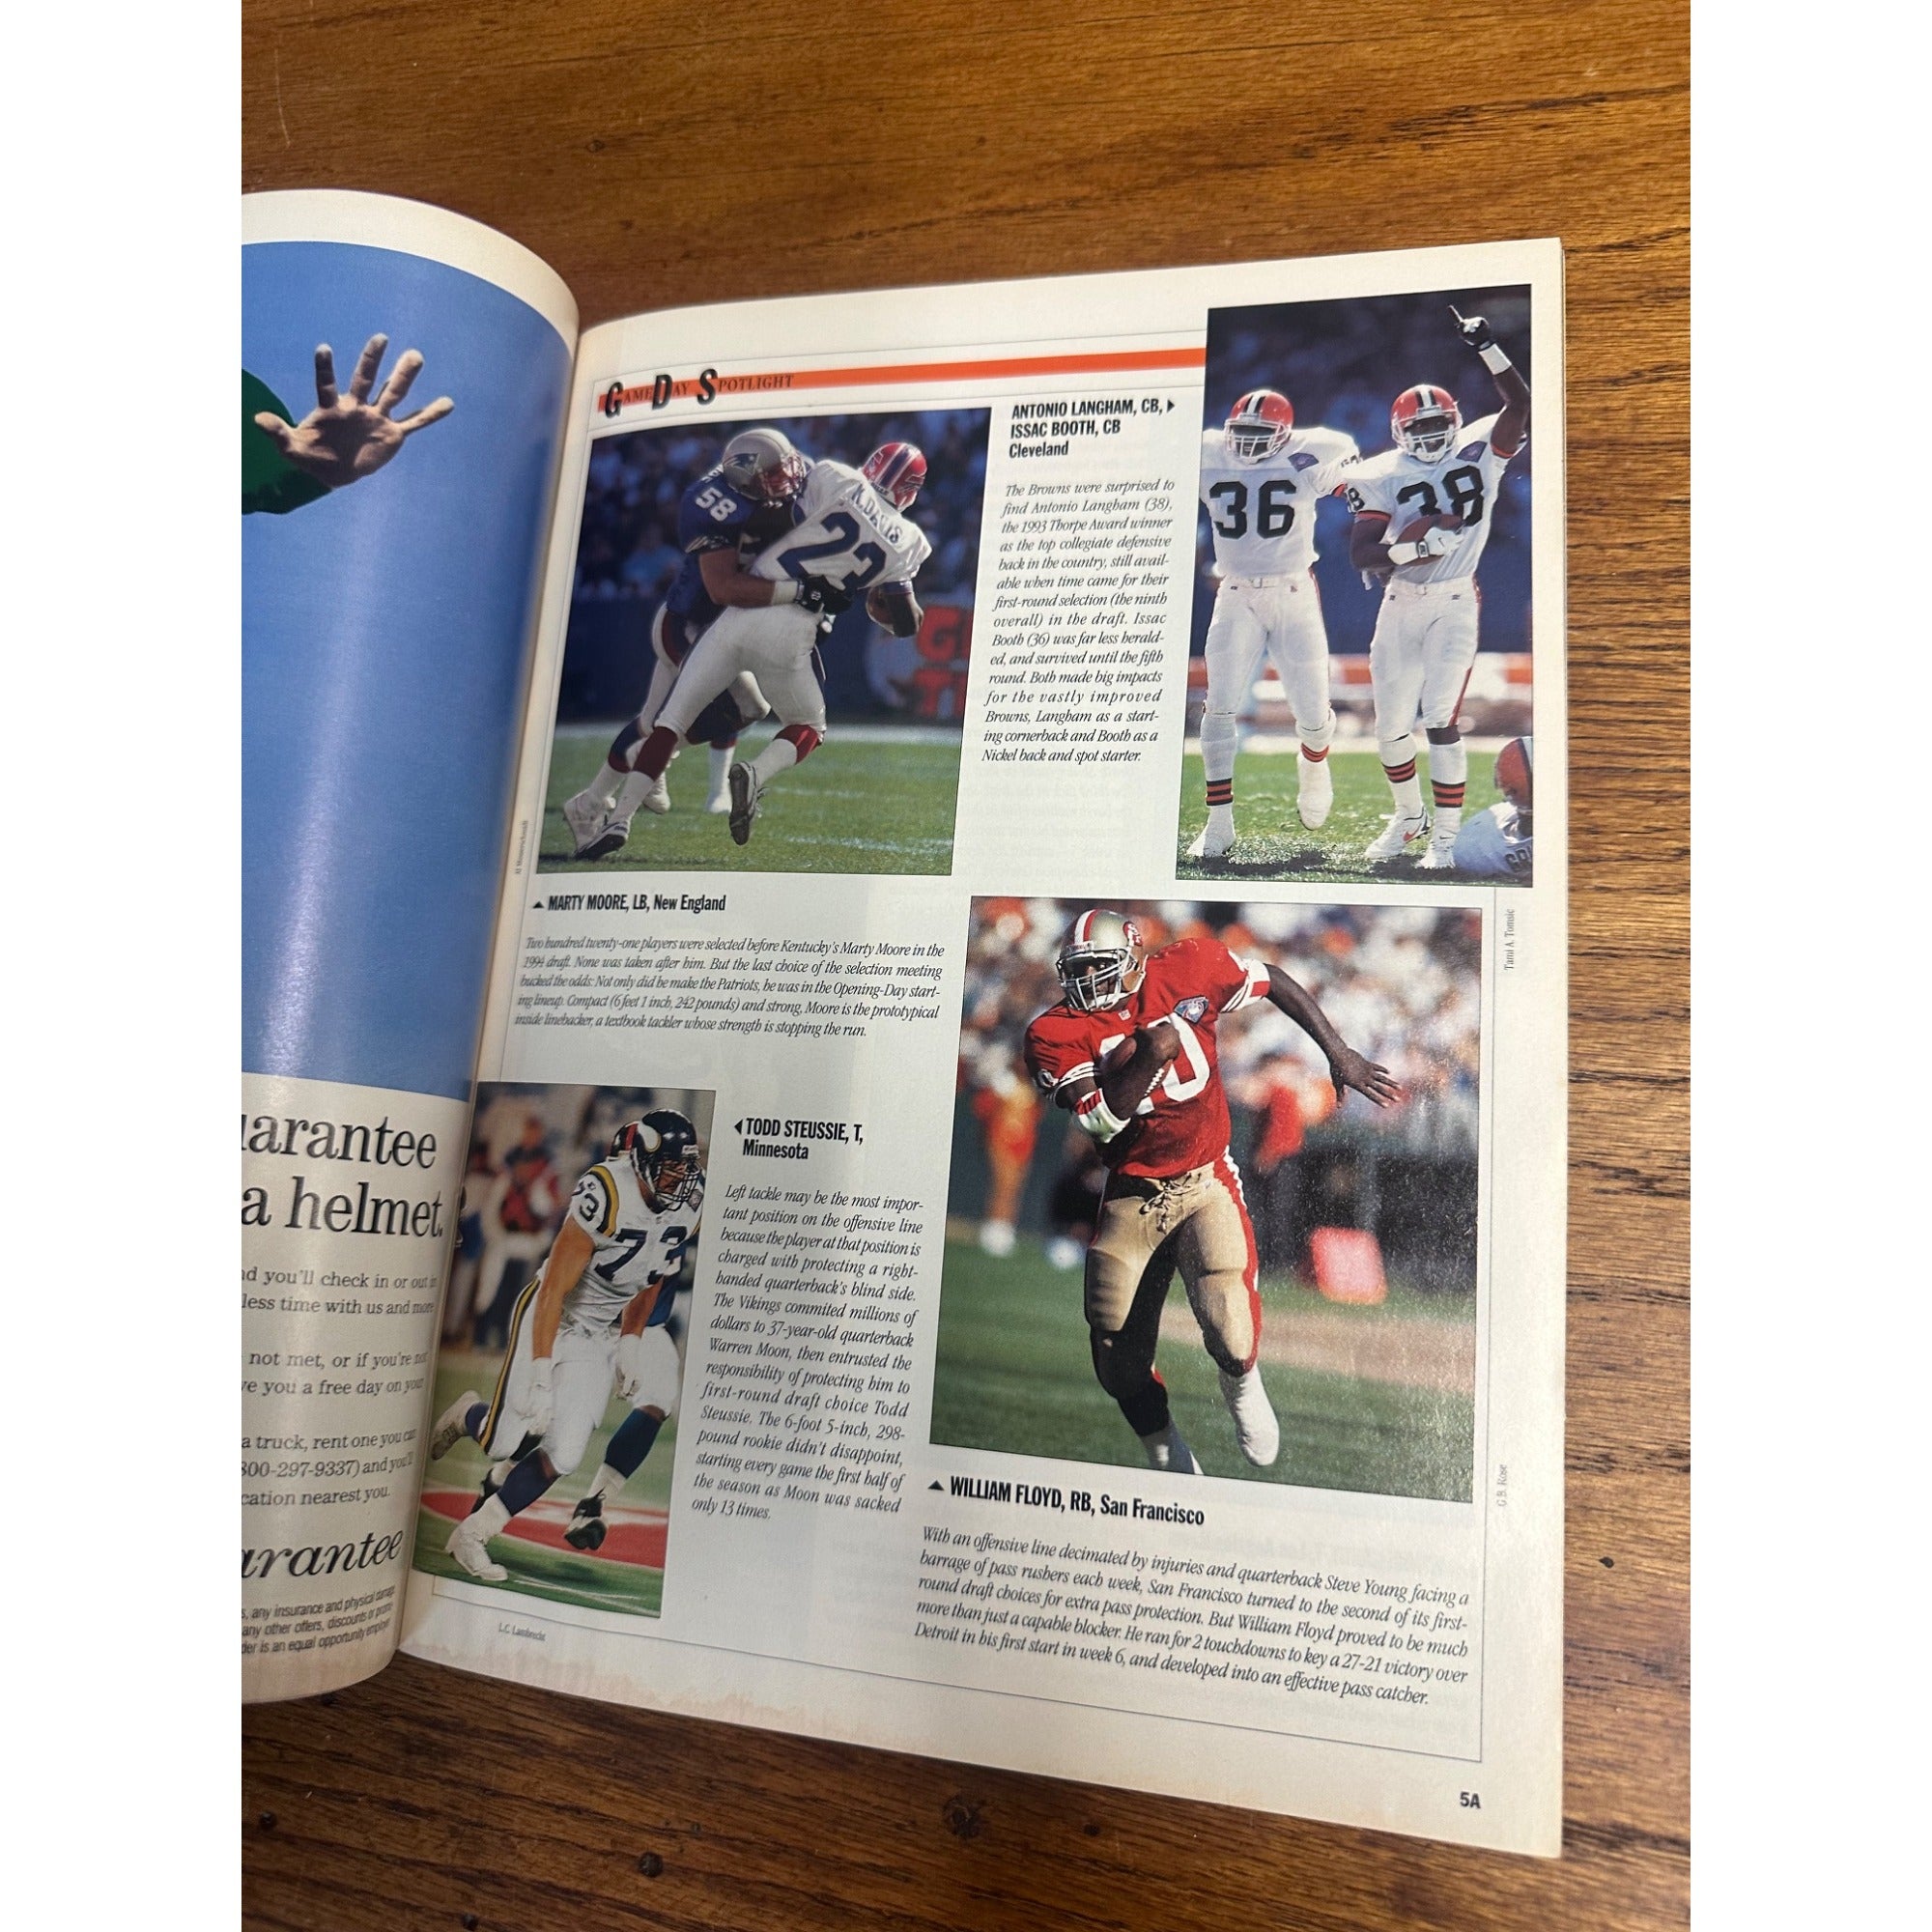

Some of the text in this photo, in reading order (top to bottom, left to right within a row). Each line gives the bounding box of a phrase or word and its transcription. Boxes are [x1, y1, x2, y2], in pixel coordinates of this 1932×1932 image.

[696, 368, 794, 405] SPOTLIGHT
[1011, 398, 1163, 419] ANTONIO LANGHAM, CB,
[1010, 419, 1121, 439] ISSAC BOOTH, CB
[1009, 440, 1069, 459] Cleveland
[696, 487, 737, 522] 58
[1000, 497, 1172, 519] find Antonio Langham (38),
[1209, 479, 1296, 539] 36
[1002, 516, 1173, 534] the 1993 Thorpe Award winner
[983, 689, 1163, 707] for the vastly improved
[984, 709, 1159, 725] Browns, Langham as a start-
[548, 895, 726, 914] MARTY MOORE, LB, New England
[544, 936, 586, 949] hundred
[583, 936, 640, 952] twenty-one
[639, 936, 678, 952] players
[679, 940, 704, 950] were
[704, 937, 747, 951] selected
[747, 938, 780, 954] before
[781, 940, 839, 956] Kentucky's
[839, 942, 874, 958] Marty
[874, 943, 911, 955] Moore
[912, 944, 925, 956] in
[926, 943, 945, 956] the
[595, 1017, 604, 1026] a
[605, 1014, 646, 1028] textbook
[647, 1015, 683, 1029] tackler
[684, 1016, 717, 1030] whose
[717, 1018, 762, 1035] strength
[764, 1020, 775, 1033] is
[775, 1021, 822, 1038] stopping
[823, 1021, 841, 1036] the
[843, 1026, 867, 1037] run.
[242, 1114, 437, 1169] arantee
[746, 1118, 863, 1146] TODD STEUSSIE, T,
[743, 1138, 809, 1159] Minnesota
[242, 1176, 442, 1237] a helmet.
[594, 1226, 688, 1285] 73
[262, 1270, 314, 1286] you'll
[320, 1271, 370, 1288] check
[374, 1274, 388, 1288] in
[393, 1278, 409, 1289] or
[280, 1296, 321, 1313] time
[325, 1299, 362, 1314] with
[366, 1303, 384, 1315] us
[385, 1300, 411, 1315] and
[710, 1315, 914, 1348] dollars to 37-year-old quarterback
[248, 1352, 280, 1366] not
[286, 1353, 325, 1370] met,
[331, 1356, 351, 1368] or
[355, 1352, 370, 1368] if
[710, 1337, 912, 1371] Warren Moon, then entrusted the
[262, 1381, 296, 1397] you
[301, 1383, 313, 1394] a
[318, 1379, 352, 1395] free
[355, 1379, 384, 1397] day
[385, 1381, 402, 1393] on
[700, 1405, 905, 1440] Steussie. The 6-foot 5-inch, 298-
[256, 1435, 308, 1452] truck,
[312, 1435, 349, 1449] rent
[351, 1435, 378, 1448] one
[379, 1433, 402, 1448] you
[361, 1457, 388, 1474] and
[299, 1488, 362, 1505] nearest
[362, 1487, 390, 1504] you.
[951, 1476, 1205, 1525] WILLIAM FLOYD, RB, San Francisco
[923, 1526, 1468, 1608] With an offensive line decimated by injuries and quarterback Steve Young facing a
[1460, 1791, 1481, 1808] 5A
